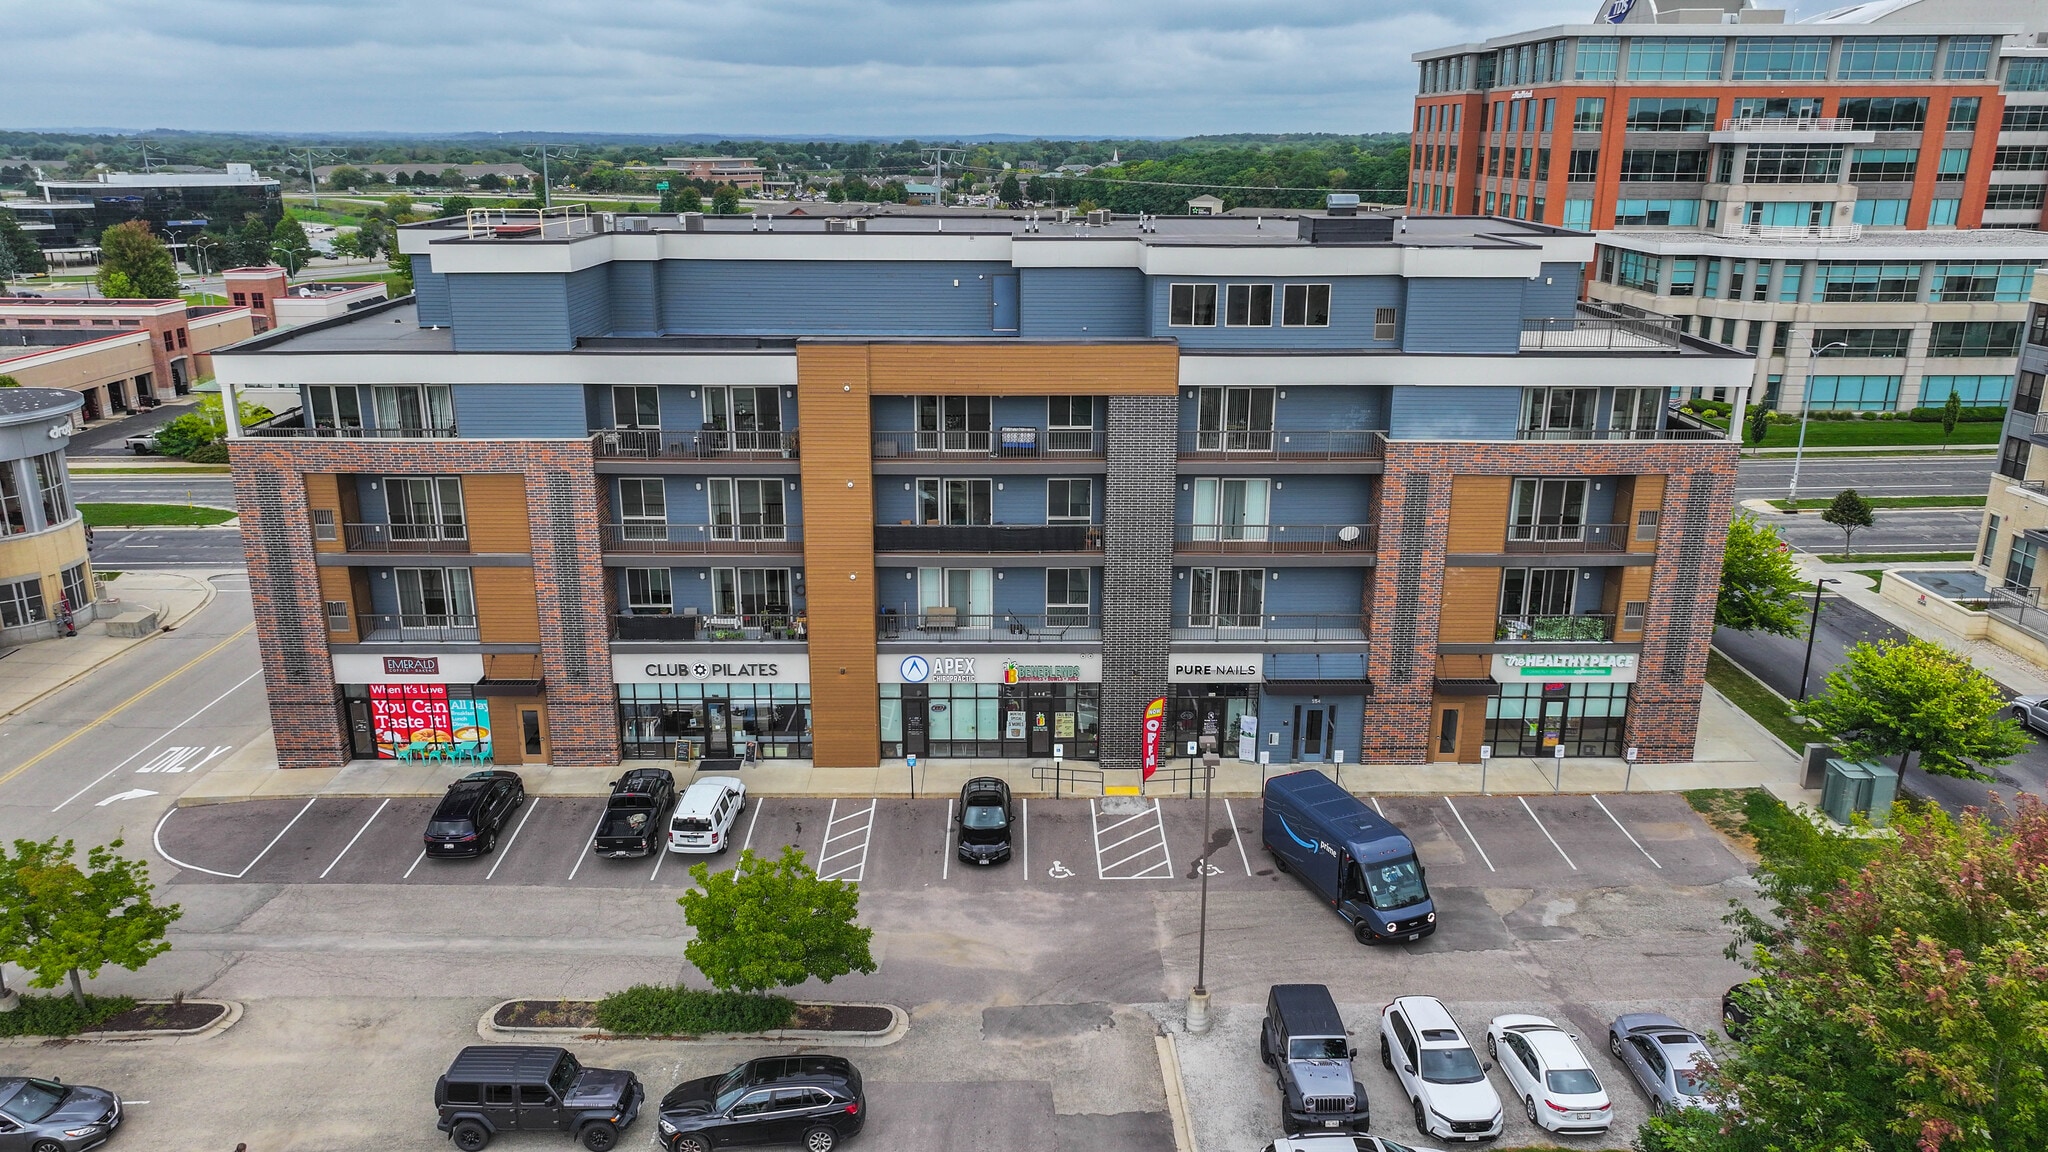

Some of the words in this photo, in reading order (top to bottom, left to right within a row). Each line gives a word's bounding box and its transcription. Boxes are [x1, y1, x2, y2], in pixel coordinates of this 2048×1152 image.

[387, 659, 435, 669] EMERALD
[933, 657, 976, 675] APEX
[1504, 656, 1526, 667] the
[1525, 655, 1588, 667] HEALTHY
[1592, 655, 1634, 668] PLACE
[645, 664, 689, 677] CLUB
[712, 664, 778, 677] PILATES
[1018, 665, 1080, 678] BENEBLENDS
[1176, 665, 1211, 676] PURE
[1216, 665, 1256, 676] NAILS
[371, 686, 400, 694] When
[404, 686, 418, 694] It's
[421, 686, 443, 694] Love
[373, 701, 405, 713] You
[412, 700, 448, 713] Can
[451, 700, 467, 710] All
[469, 700, 489, 712] Day
[376, 716, 424, 728] Taste
[430, 715, 447, 728] It!
[1146, 720, 1160, 768] OPEN
[135, 746, 232, 773] ONLY
[1320, 840, 1337, 858] prime
